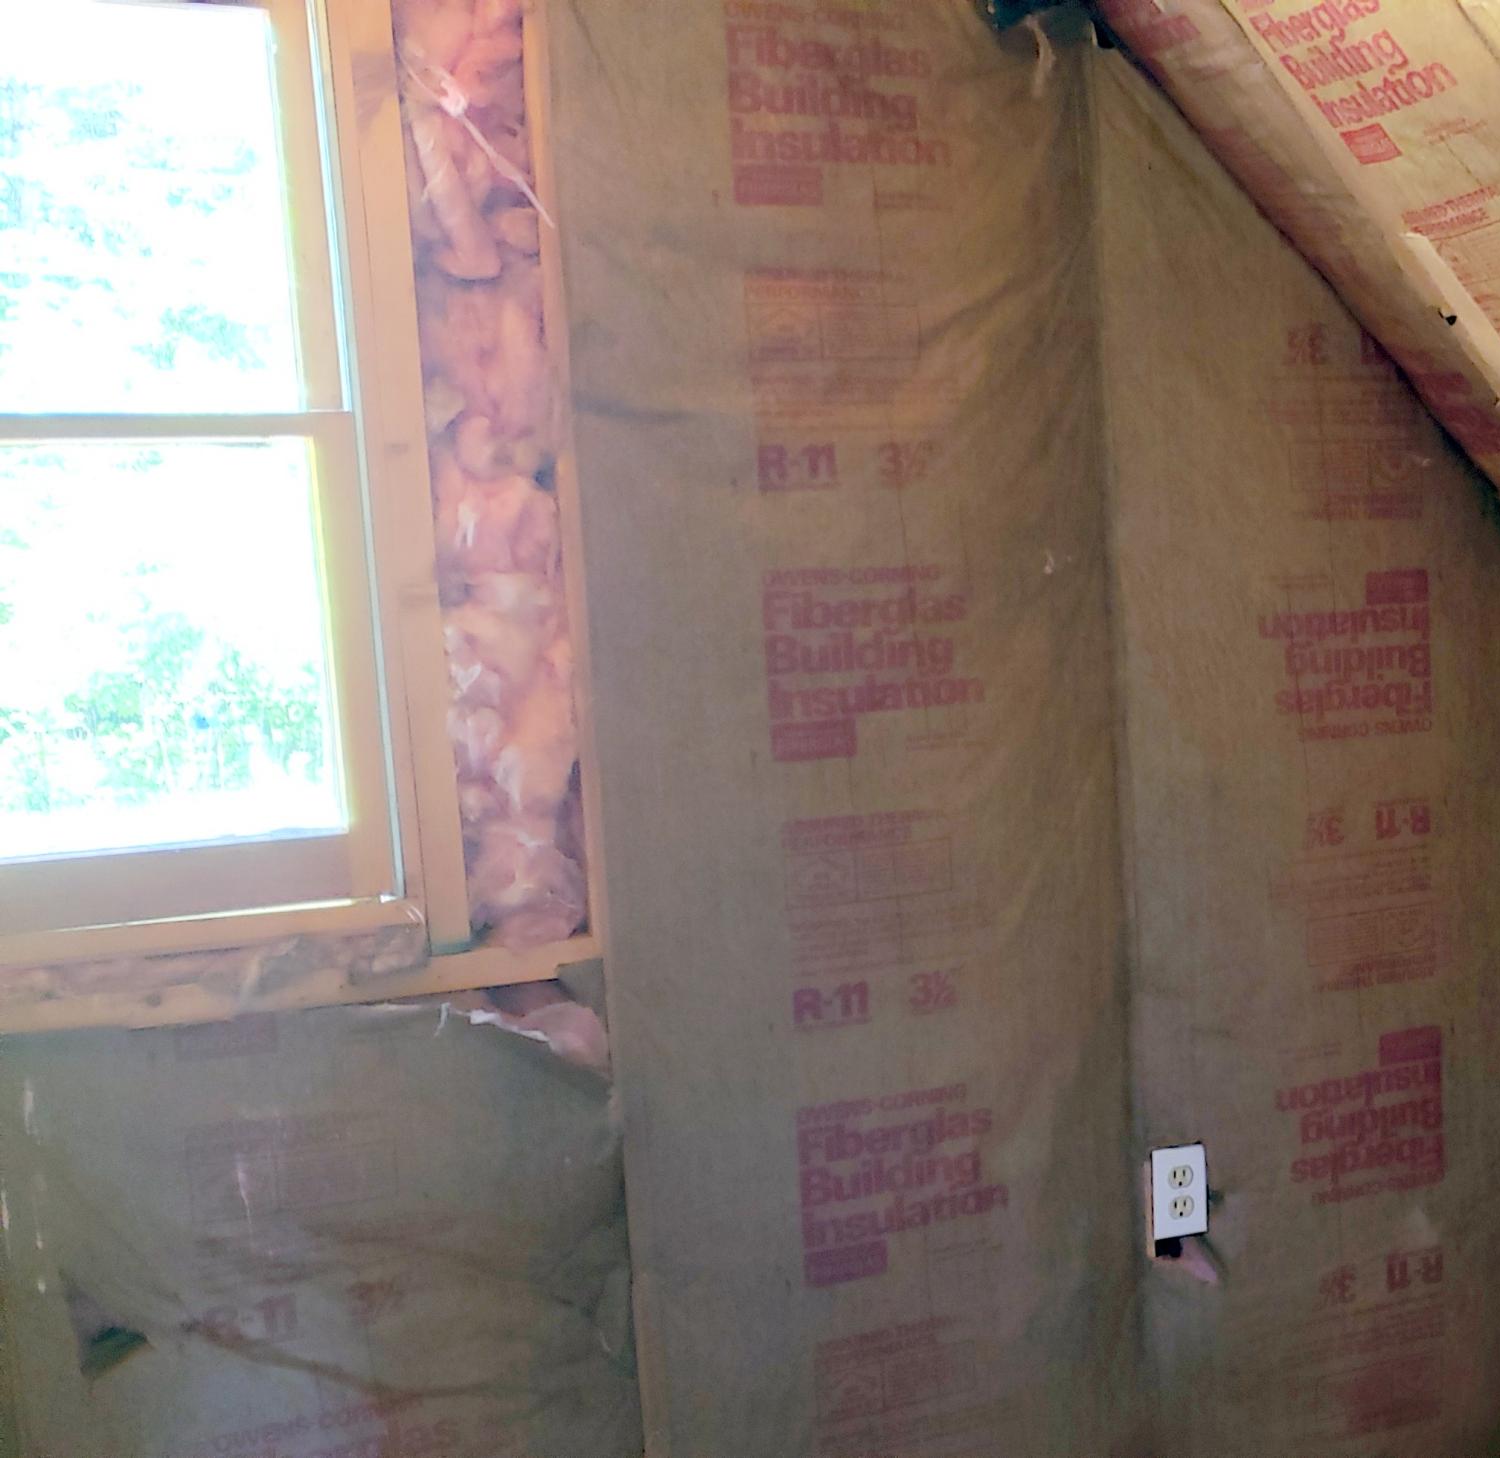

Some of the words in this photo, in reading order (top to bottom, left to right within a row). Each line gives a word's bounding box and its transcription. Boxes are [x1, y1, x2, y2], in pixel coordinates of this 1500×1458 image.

[1249, 0, 1380, 54] Fiberglas
[726, 24, 933, 84] Fiberglas
[1279, 29, 1409, 91] Building
[729, 72, 918, 132] Building
[1310, 62, 1458, 129] Insulation
[731, 117, 953, 166] Insulation
[757, 443, 838, 481] R-11
[763, 586, 967, 635] Fiberglas
[1257, 606, 1430, 643] Insulation
[766, 631, 954, 678] Building
[1283, 640, 1431, 682] Building
[768, 674, 986, 720] Insulation
[1272, 679, 1432, 725] Fiberglas
[1373, 802, 1432, 842] R-11
[792, 979, 868, 1026] R-11
[1273, 1059, 1441, 1112] Insulation
[797, 1107, 993, 1166] Fiberglas
[1299, 1094, 1442, 1146] Building
[799, 1151, 982, 1207] Building
[1289, 1132, 1443, 1186] Fiberglas
[800, 1184, 1010, 1250] Insulation
[1384, 1252, 1443, 1293] R-11
